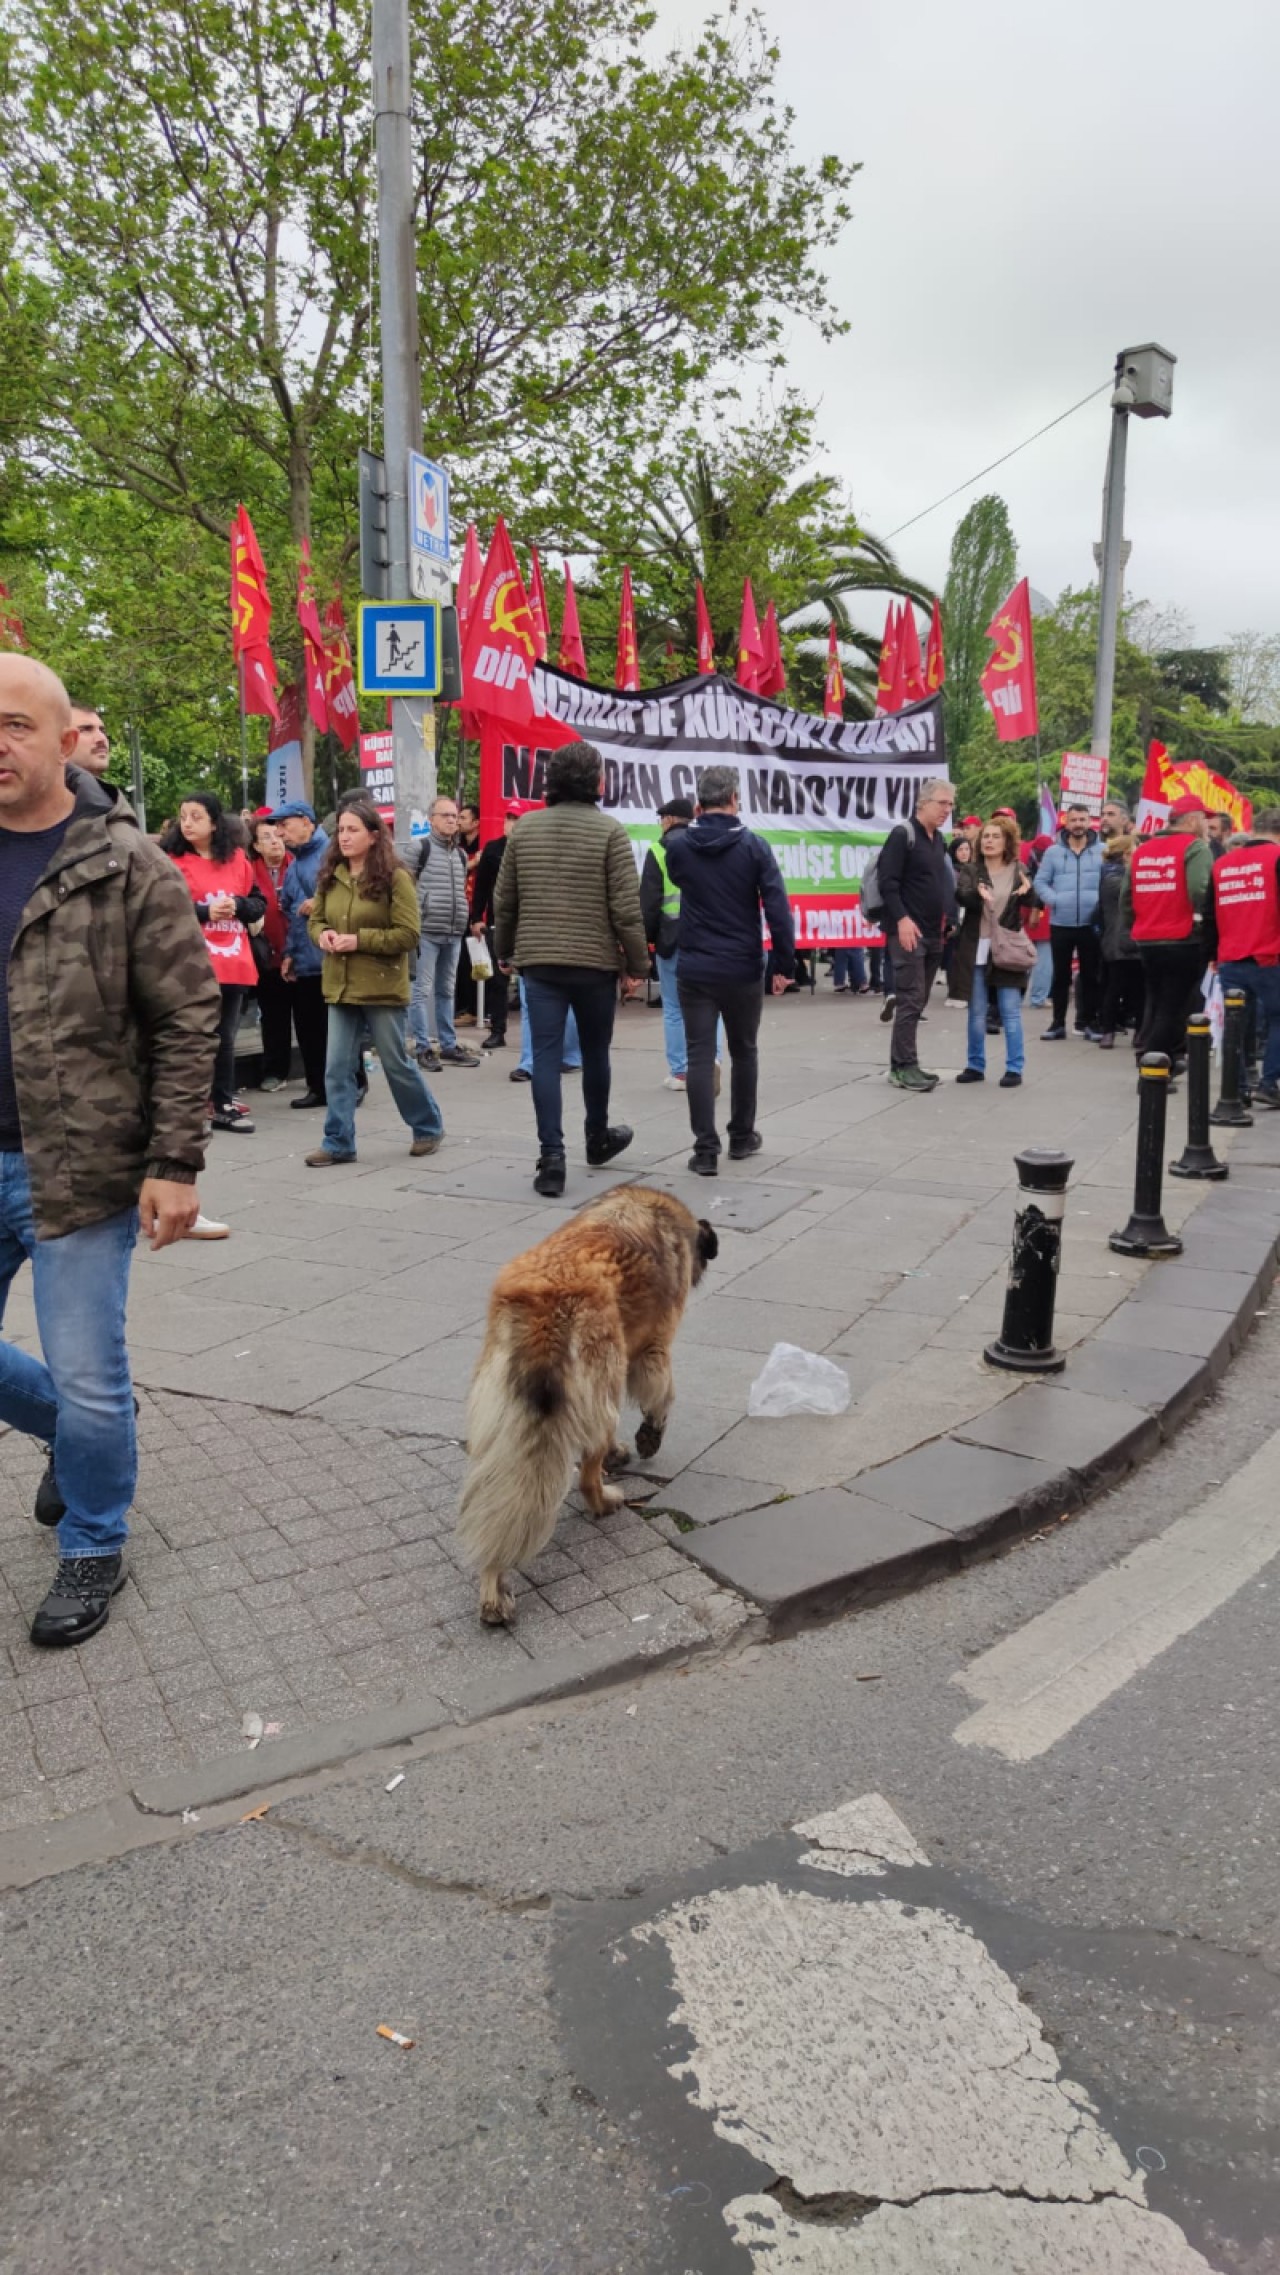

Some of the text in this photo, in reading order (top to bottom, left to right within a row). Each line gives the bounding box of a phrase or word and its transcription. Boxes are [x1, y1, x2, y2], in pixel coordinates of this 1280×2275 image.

[415, 528, 447, 557] METRO
[473, 645, 527, 691] DİP
[838, 711, 937, 754] KAPAT!
[747, 768, 877, 820] NATO'YU
[1136, 869, 1161, 880] METAL
[1219, 880, 1247, 892] METAL
